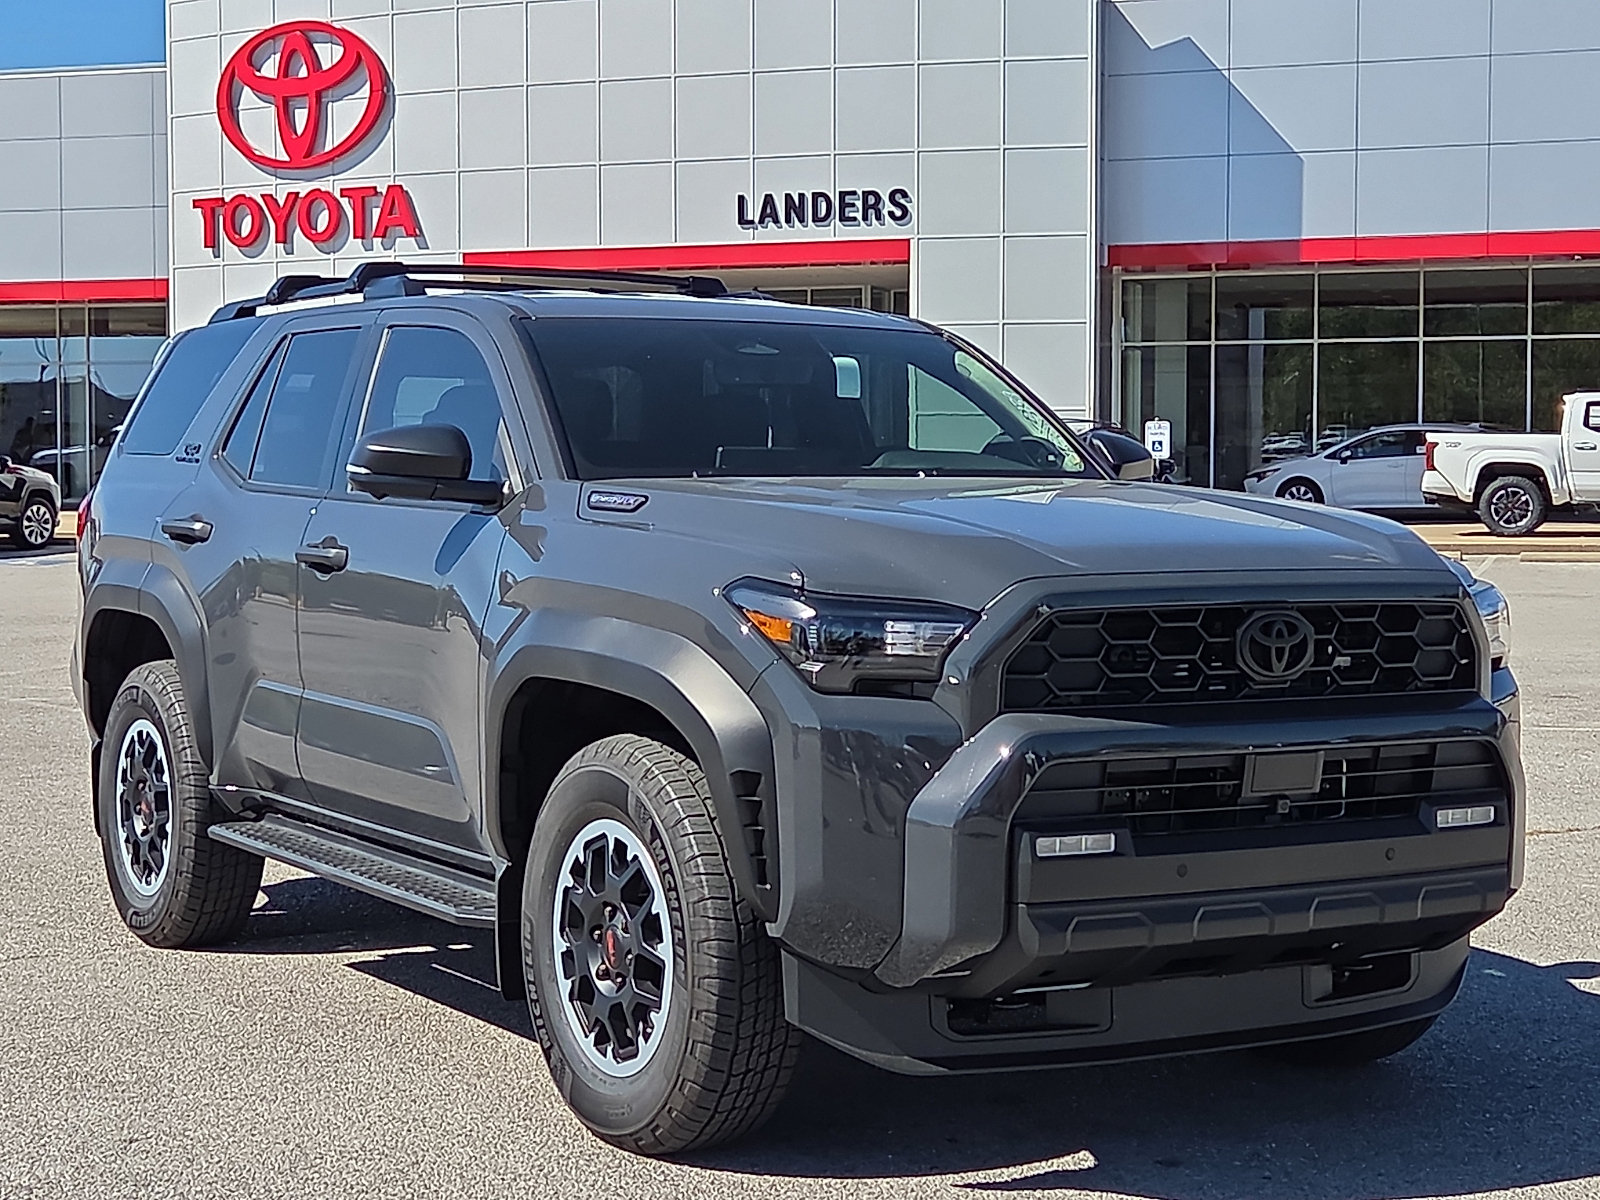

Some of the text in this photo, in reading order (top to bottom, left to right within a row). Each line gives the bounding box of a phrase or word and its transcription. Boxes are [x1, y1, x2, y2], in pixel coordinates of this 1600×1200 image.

[193, 185, 420, 249] TOYOTA
[737, 188, 911, 228] LANDERS
[651, 838, 686, 982] MICHELIN
[523, 918, 552, 1050] MICHELIN
